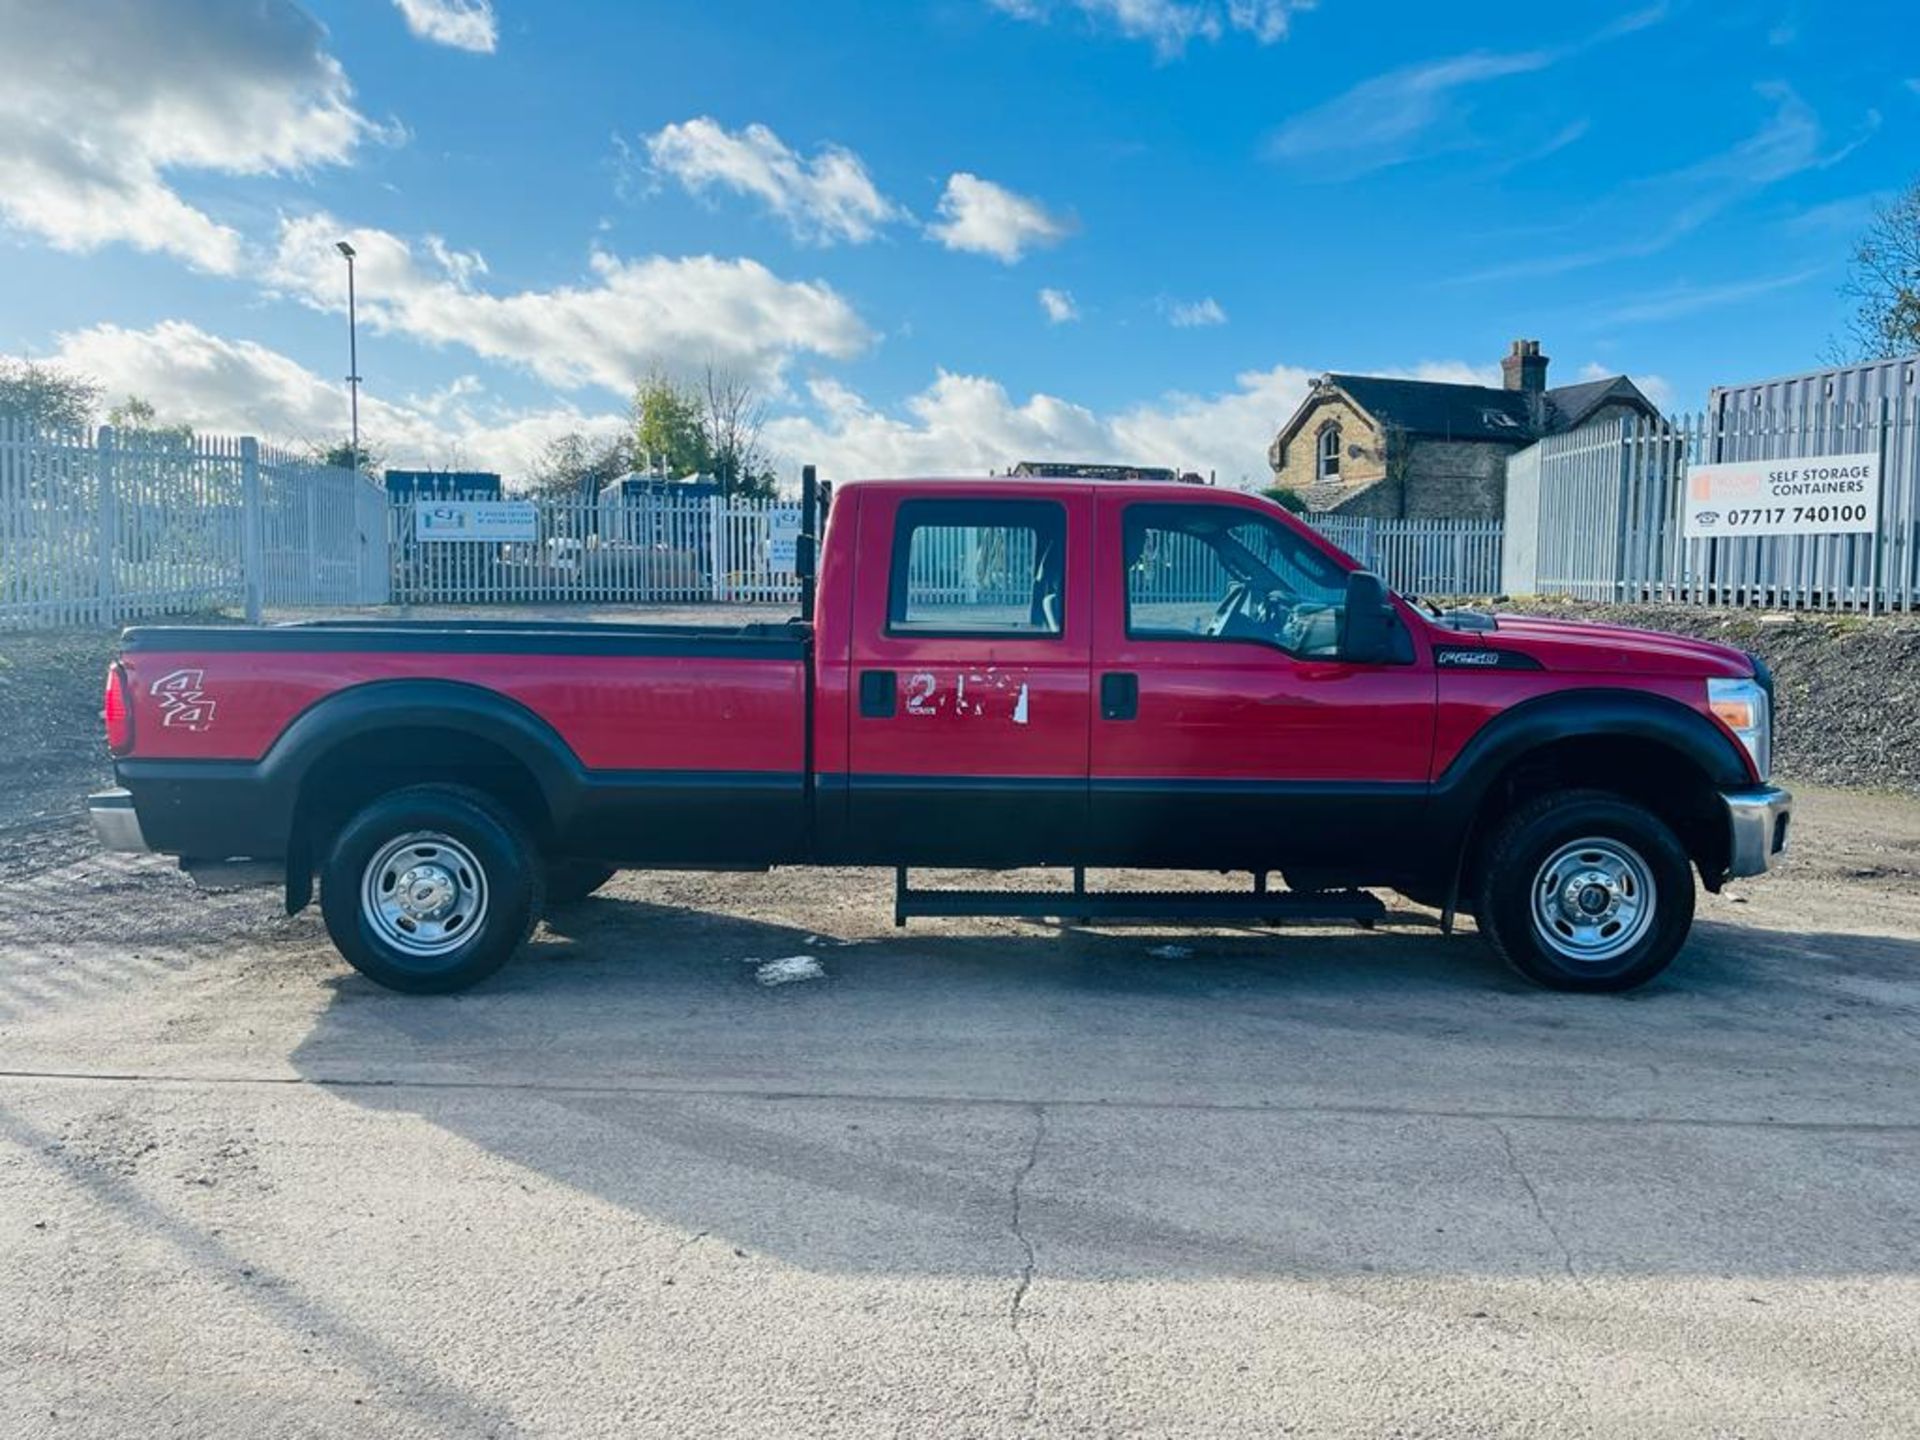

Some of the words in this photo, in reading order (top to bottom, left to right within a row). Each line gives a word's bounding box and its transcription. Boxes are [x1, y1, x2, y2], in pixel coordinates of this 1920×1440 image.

[1769, 471, 1798, 483] SELF
[1803, 466, 1870, 481] STORAGE
[1772, 481, 1864, 496] CONTAINERS
[1727, 508, 1786, 525] 07717
[1793, 504, 1867, 523] 740100
